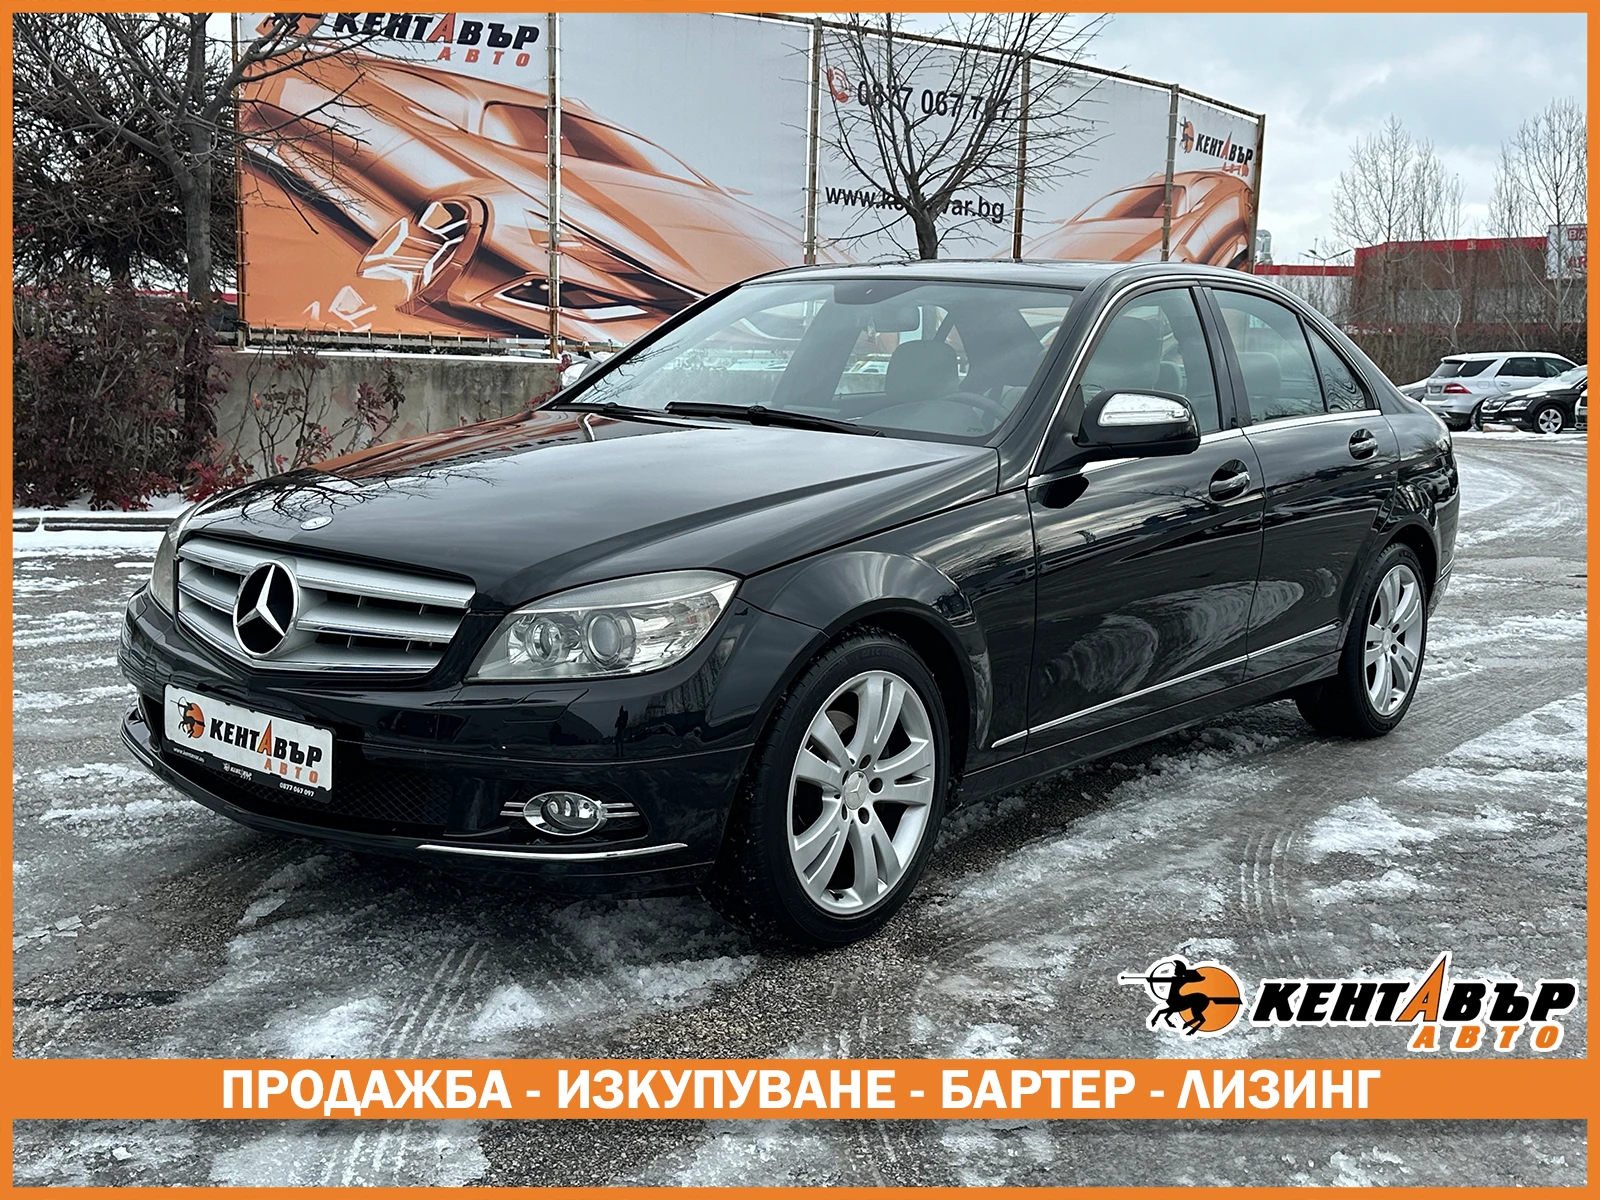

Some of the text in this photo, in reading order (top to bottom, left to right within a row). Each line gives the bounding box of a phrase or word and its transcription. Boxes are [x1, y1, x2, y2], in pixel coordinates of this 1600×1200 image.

[333, 12, 540, 50] КЕНТАВЪР
[437, 46, 531, 67] АВТО
[921, 89, 963, 117] 067
[1195, 130, 1253, 164] КЕНТАВЪР
[210, 719, 323, 768] КЕНТАВЪР
[264, 758, 319, 784] АВТО
